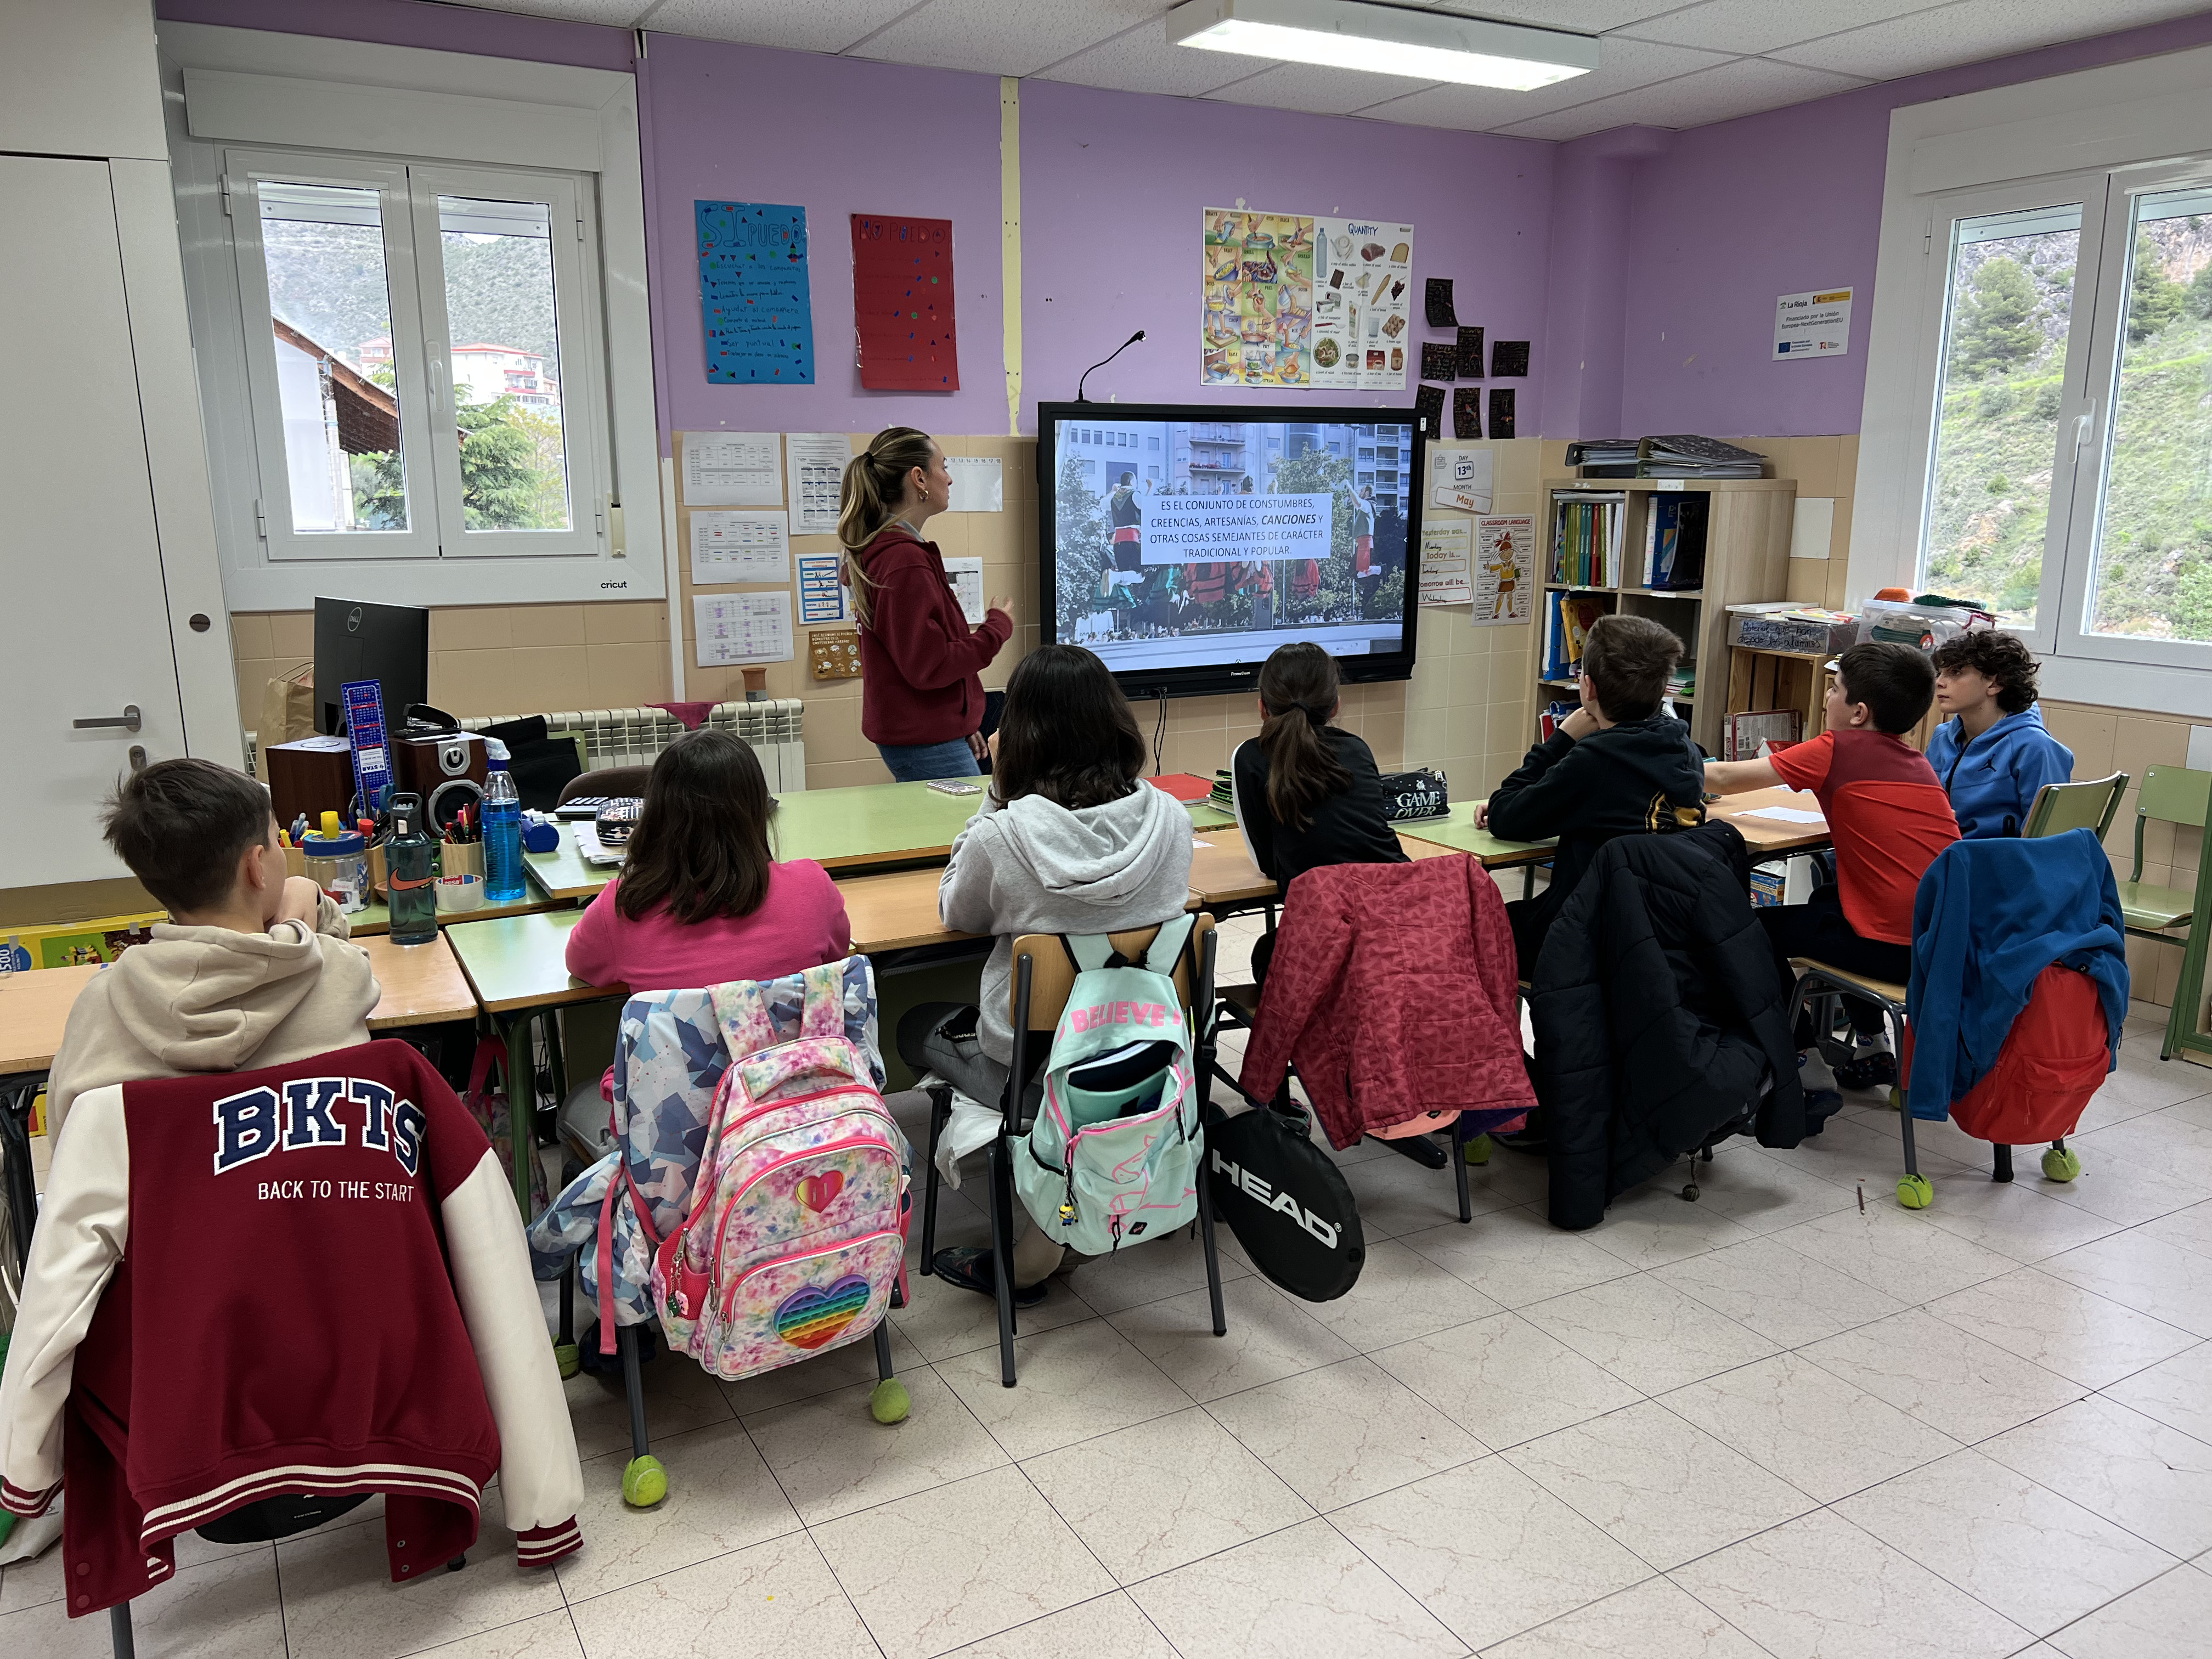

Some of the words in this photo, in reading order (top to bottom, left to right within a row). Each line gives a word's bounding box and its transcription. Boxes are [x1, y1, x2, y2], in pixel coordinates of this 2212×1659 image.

[1348, 223, 1378, 236] QUANTITY
[1457, 464, 1472, 476] 13th
[1161, 501, 1171, 510] ES
[1173, 500, 1183, 510] EL
[1186, 500, 1233, 510] CONJUNTO
[1236, 500, 1247, 510] DE
[1249, 499, 1315, 510] CONSTUMBRES,
[1456, 494, 1474, 509] May
[1151, 517, 1202, 529] CREENCIAS,
[1204, 515, 1259, 528] ARTESANÍAS,
[1262, 514, 1316, 525] CANCIONES
[1318, 515, 1323, 524] Y
[1150, 534, 1180, 544] OTRAS
[1182, 533, 1210, 543] COSAS
[1212, 532, 1266, 543] SEMEJANTES
[1268, 531, 1279, 540] DE
[1281, 528, 1323, 540] CARÁCTER
[1421, 528, 1450, 537] Yesterday
[1183, 548, 1242, 558] TRADICIONAL
[1243, 547, 1249, 556] Y
[1251, 546, 1292, 556] POPULAR.
[1424, 541, 1442, 551] Monday
[1426, 551, 1447, 560] Today
[601, 579, 627, 589] cricut
[1775, 626, 1790, 635] que
[1796, 624, 1812, 635] han
[1784, 635, 1821, 648] alumnos
[1395, 791, 1441, 808] GAME
[1394, 806, 1437, 819] OVER
[1070, 1001, 1166, 1034] BELIEVE
[213, 1077, 426, 1178] BKTS
[258, 1180, 304, 1200] BACK
[311, 1180, 331, 1199] TO
[338, 1181, 370, 1199] THE
[375, 1182, 414, 1202] START
[1211, 1148, 1339, 1250] HEAD
